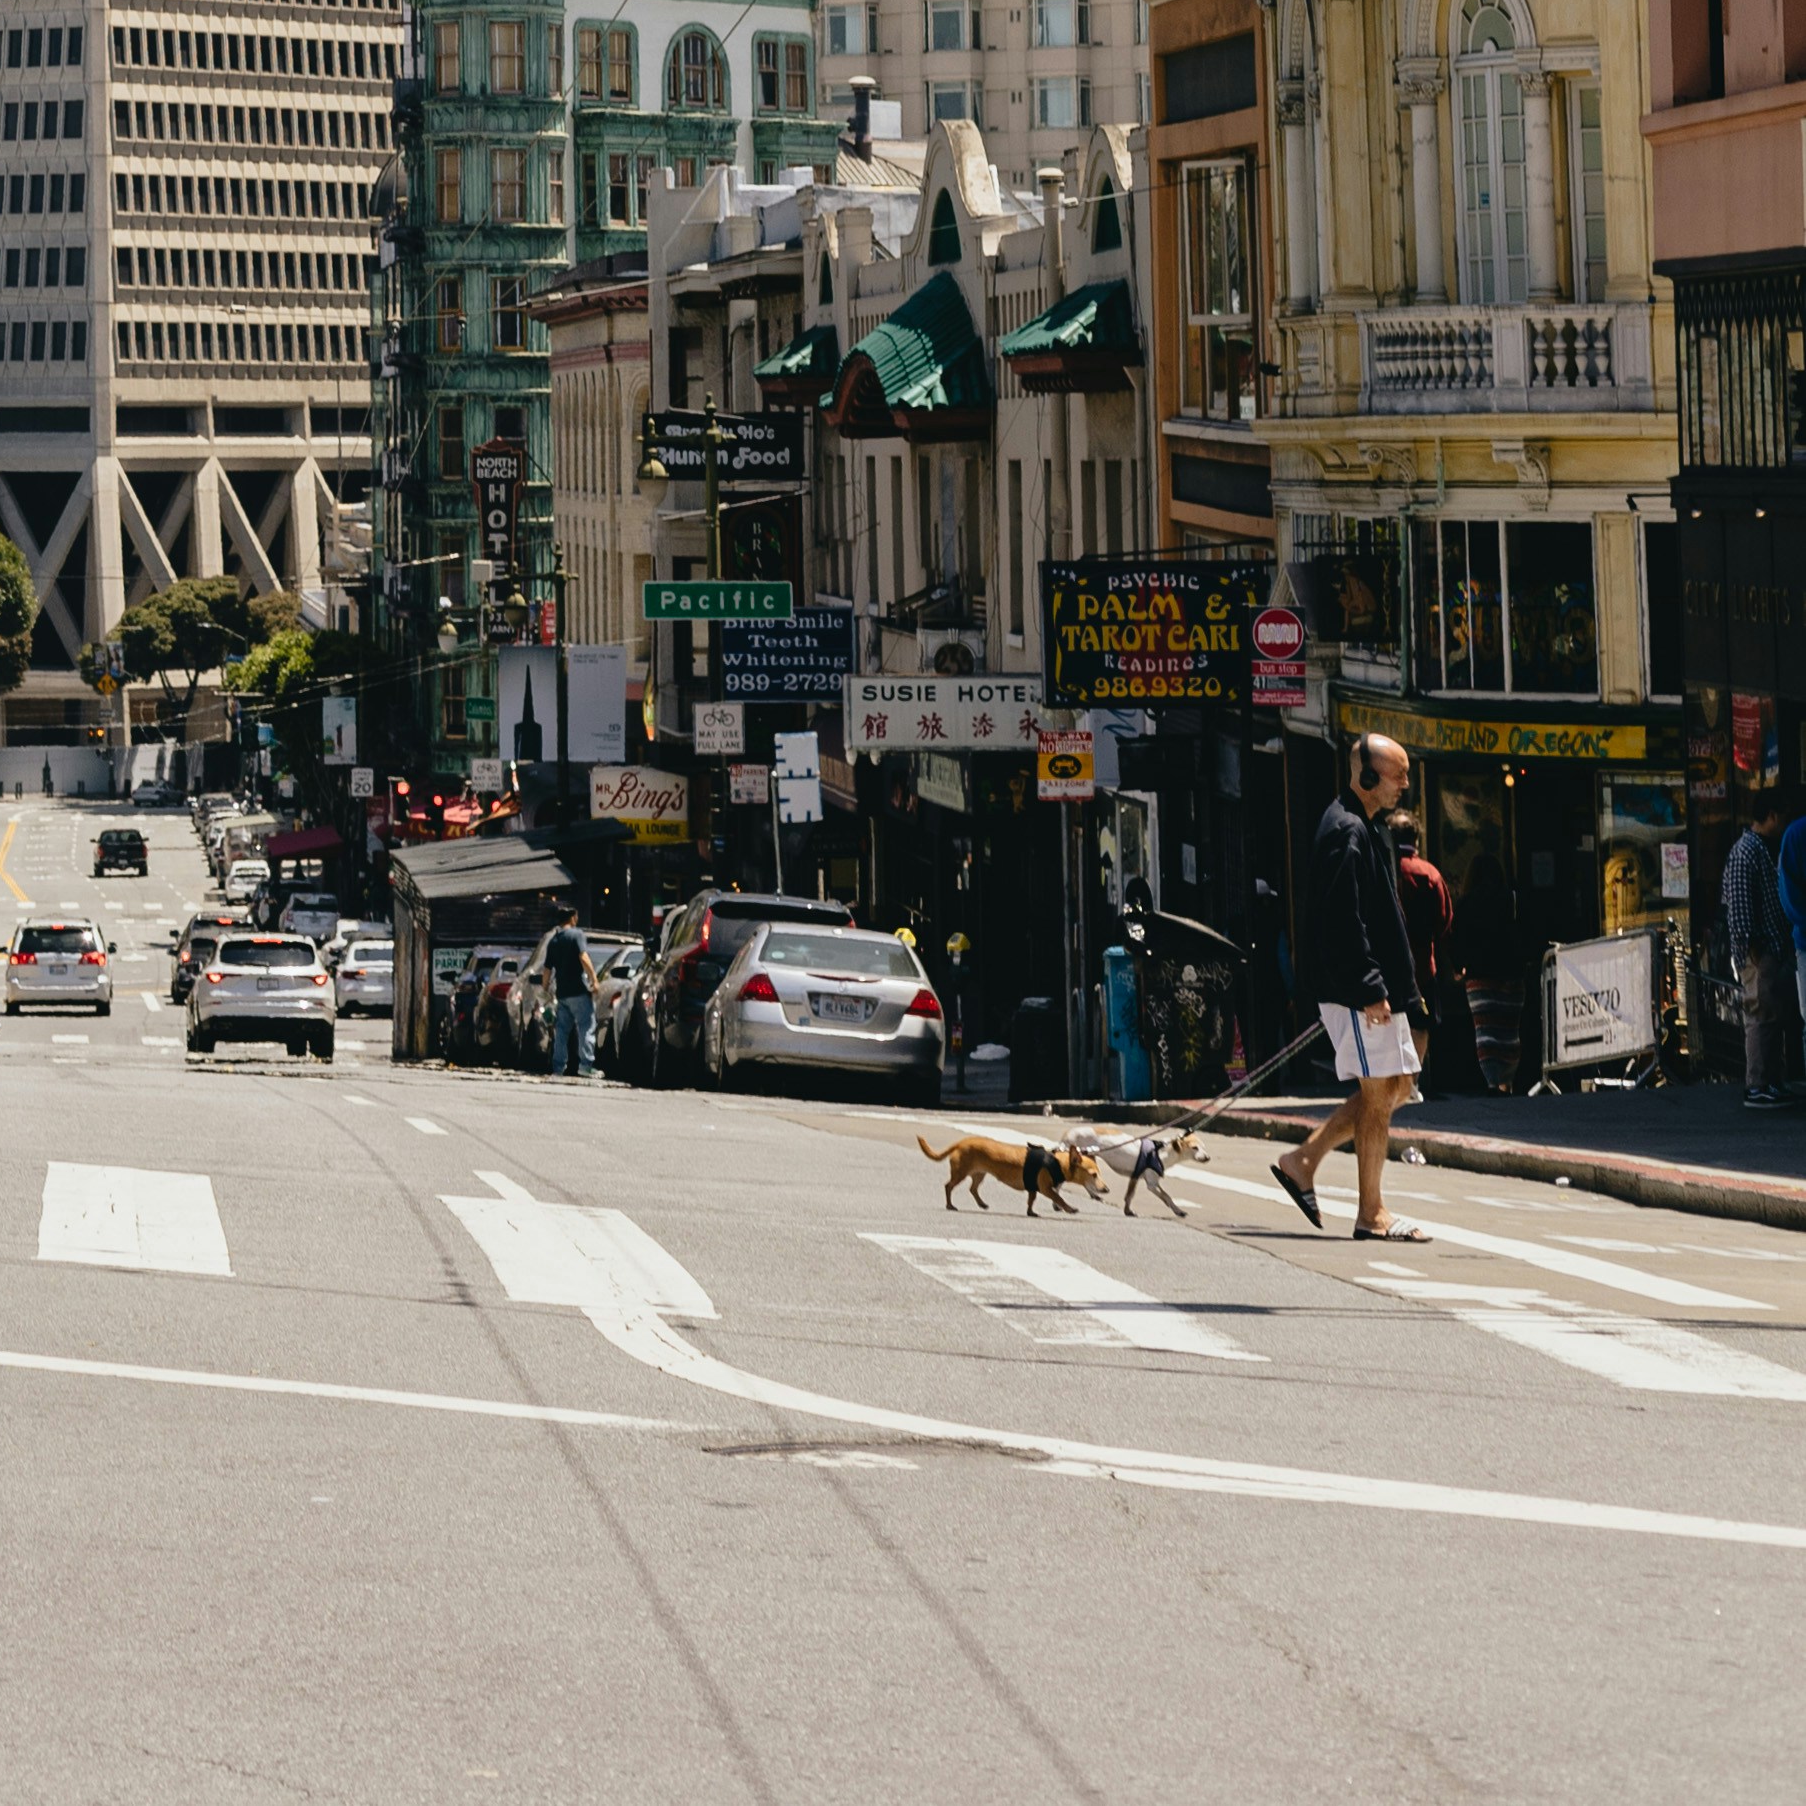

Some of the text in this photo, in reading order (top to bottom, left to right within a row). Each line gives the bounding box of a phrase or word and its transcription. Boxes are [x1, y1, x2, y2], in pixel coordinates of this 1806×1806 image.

[737, 424, 775, 440] Ho's
[476, 457, 517, 469] NORTH
[732, 446, 790, 470] Food
[476, 468, 517, 479] BEACH
[487, 483, 509, 607] HOTEL
[1108, 572, 1200, 591] PSYCHIC
[660, 591, 775, 610] Pacific
[1078, 593, 1231, 621] PALM &
[784, 613, 843, 629] Smile
[748, 634, 819, 648] Teeth
[1061, 624, 1161, 652] TAROT
[723, 653, 848, 668] Whitening
[1104, 653, 1209, 673] READINGS
[1259, 662, 1297, 676] bus stop
[725, 673, 843, 691] 989-2729
[1094, 676, 1222, 698] 986.9320
[862, 685, 937, 702] SUSIE
[698, 730, 740, 738] MAY USE
[697, 741, 741, 749] FULL LANE
[1040, 741, 1055, 754] NO
[354, 782, 372, 793] 20
[595, 771, 686, 820] MR. Bing's
[646, 823, 681, 836] LOUNGE
